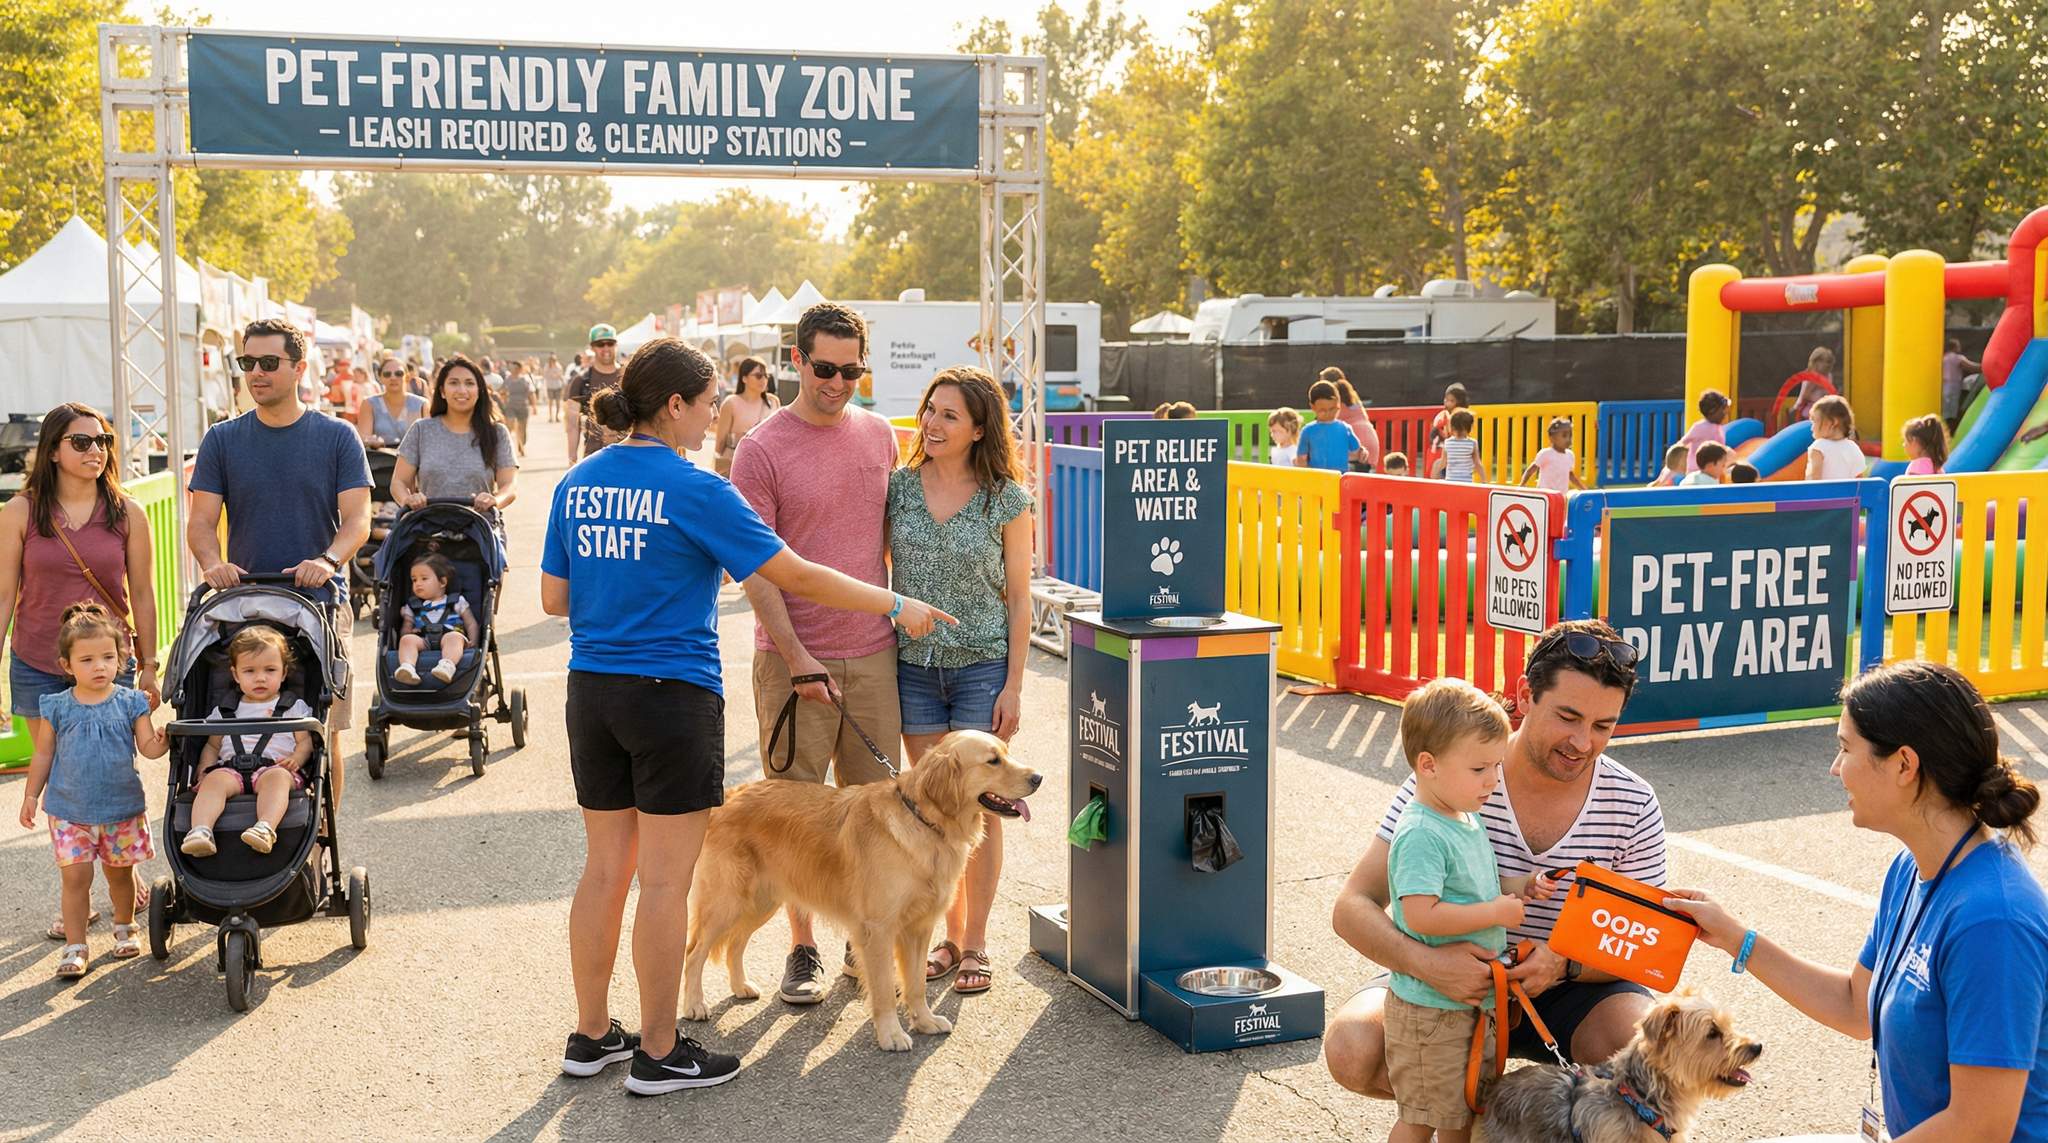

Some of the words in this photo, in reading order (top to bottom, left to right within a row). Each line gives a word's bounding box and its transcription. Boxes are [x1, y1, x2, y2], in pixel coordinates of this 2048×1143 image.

[266, 48, 607, 113] PET-FRIENDLY
[624, 60, 786, 118] FAMILY
[800, 65, 915, 121] ZONE
[349, 117, 432, 151] LEASH
[441, 119, 567, 155] REQUIRED
[576, 122, 597, 153] &
[605, 123, 719, 155] CLEANUP
[727, 126, 842, 158] STATIONS
[1115, 439, 1150, 464] PET
[1156, 438, 1218, 463] RELIEF
[1131, 468, 1180, 493] AREA
[1185, 467, 1201, 492] &
[565, 486, 669, 525] FESTIVAL
[1135, 496, 1197, 521] WATER
[577, 524, 648, 560] STAFF
[1631, 545, 1831, 616] PET-FREE
[1896, 562, 1913, 580] NO
[1916, 560, 1945, 579] PETS
[1494, 575, 1509, 595] NO
[1511, 577, 1538, 599] PETS
[1892, 580, 1948, 601] ALLOWED
[1491, 595, 1540, 621] ALLOWED
[1732, 614, 1833, 677] AREA
[1079, 714, 1121, 757] FESTIVAL
[1160, 727, 1249, 760] FESTIVAL
[1591, 908, 1660, 946] OOPS
[1598, 933, 1640, 961] KIT
[1234, 1015, 1281, 1035] FESTIVAL
